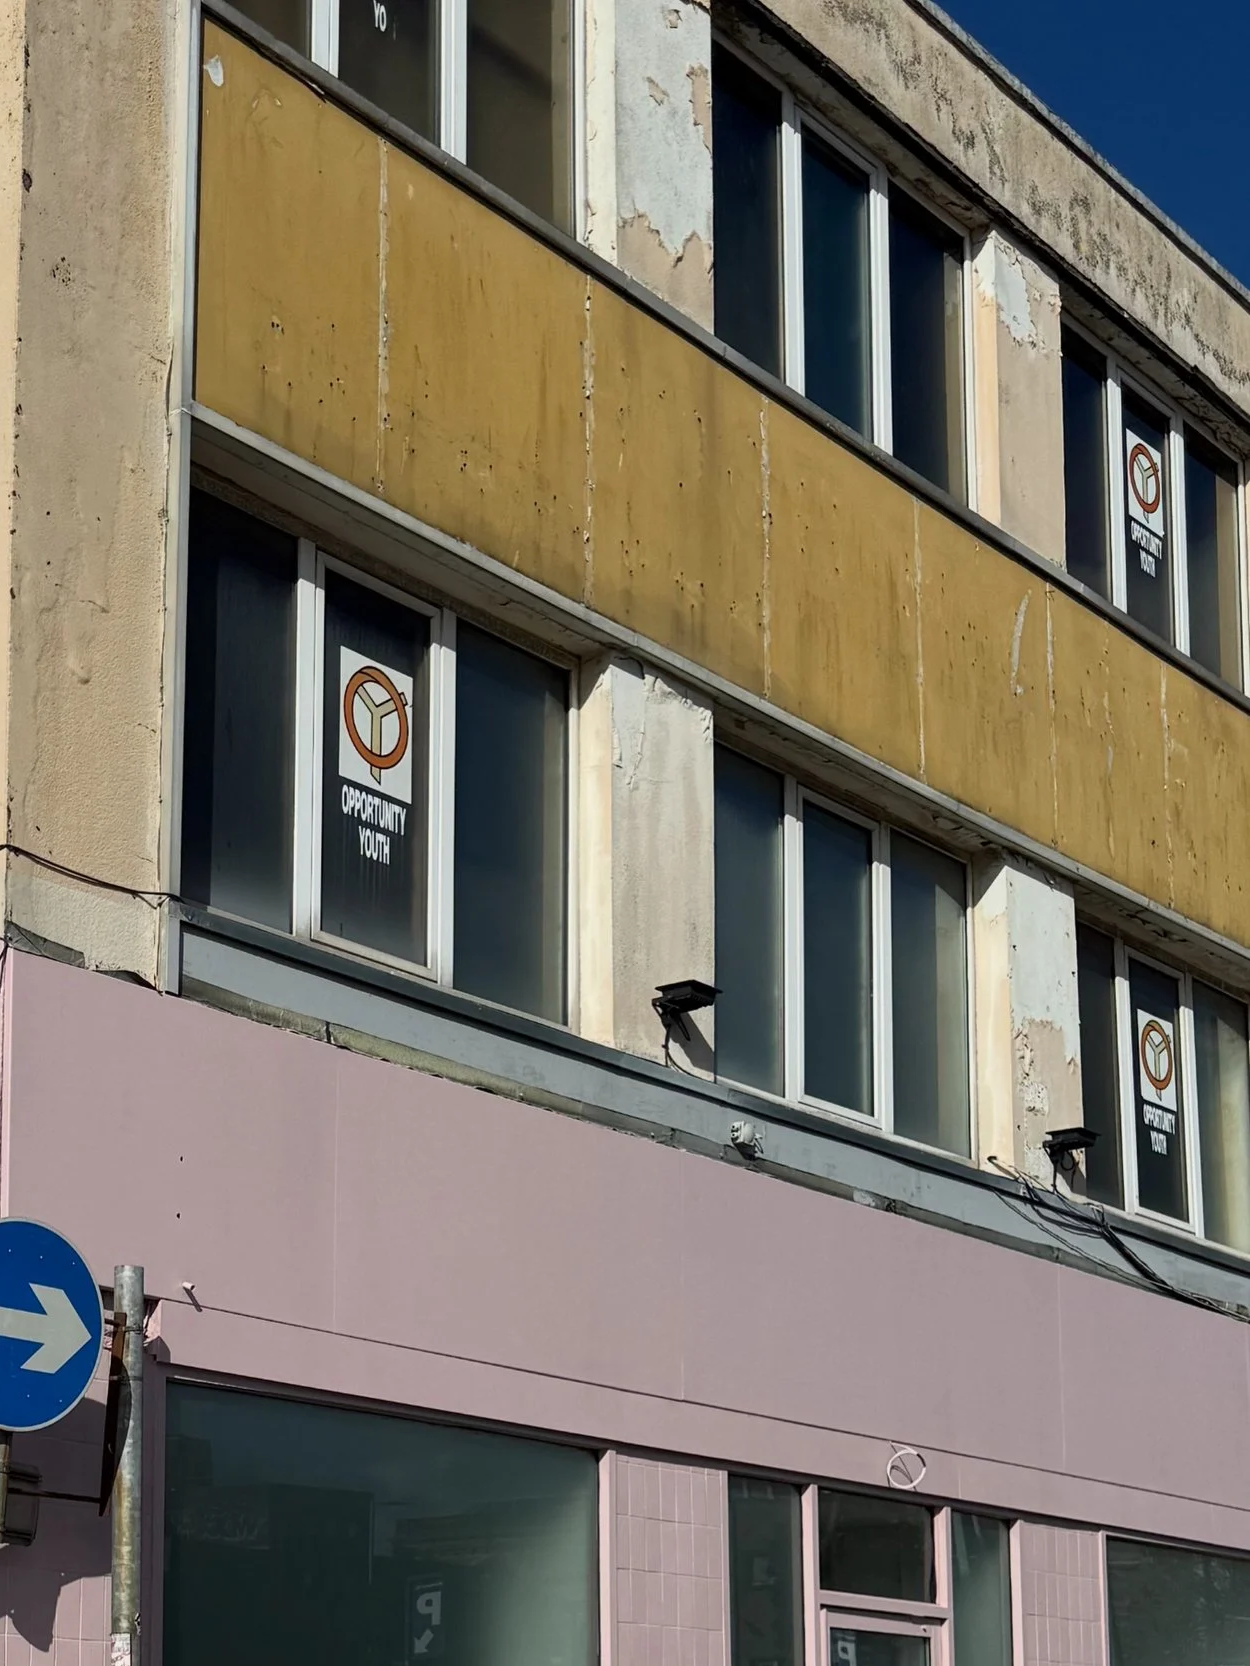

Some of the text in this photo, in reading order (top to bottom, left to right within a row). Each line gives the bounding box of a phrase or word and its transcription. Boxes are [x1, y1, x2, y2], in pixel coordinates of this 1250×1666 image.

[1131, 520, 1162, 560] OPPORTUNITY
[1140, 548, 1156, 577] YOUTH
[342, 784, 407, 836] OPPORTUNITY
[358, 826, 390, 865] YOUTH
[1143, 1103, 1176, 1135] OPPORTUNITY
[1150, 1130, 1168, 1155] YOUTH
